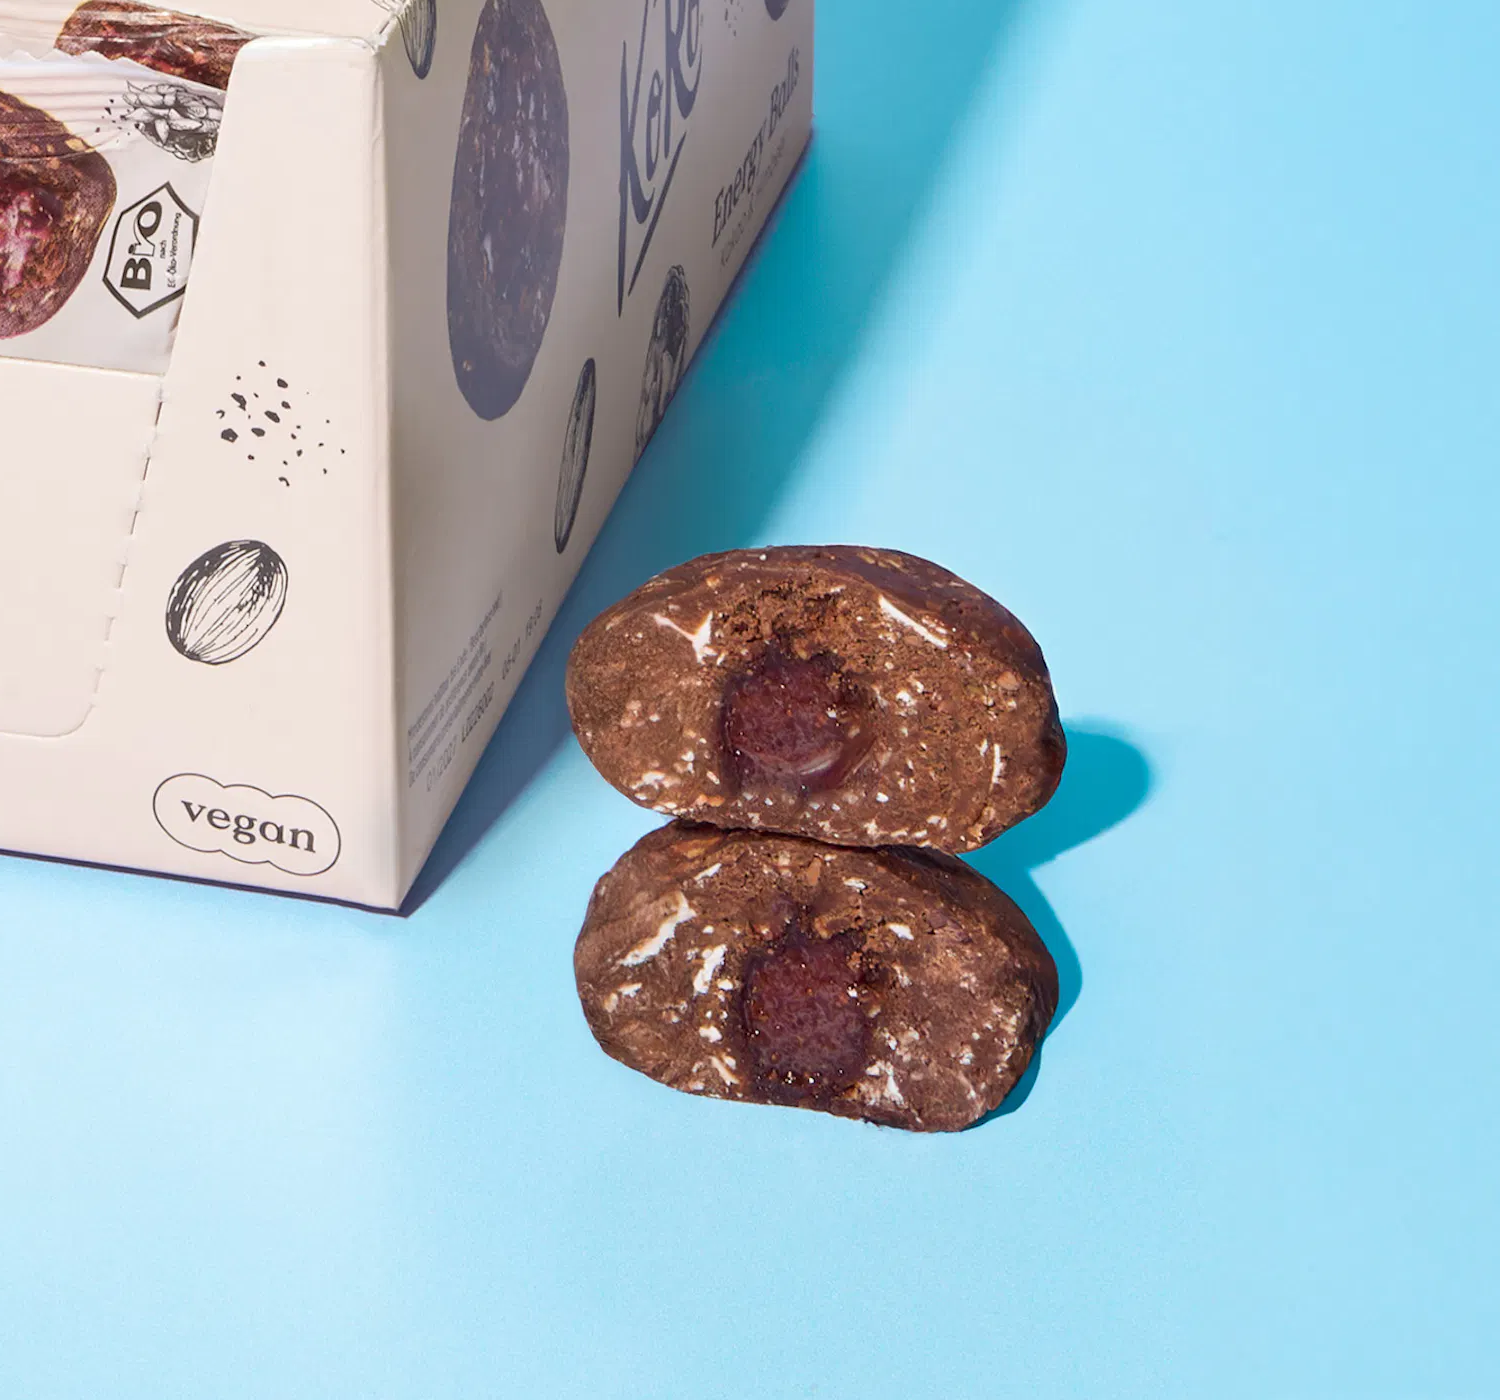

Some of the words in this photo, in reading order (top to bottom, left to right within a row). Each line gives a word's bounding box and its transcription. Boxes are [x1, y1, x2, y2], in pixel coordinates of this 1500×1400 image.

[711, 117, 767, 248] Energy
[768, 44, 801, 138] Balls
[181, 800, 316, 853] vegan
